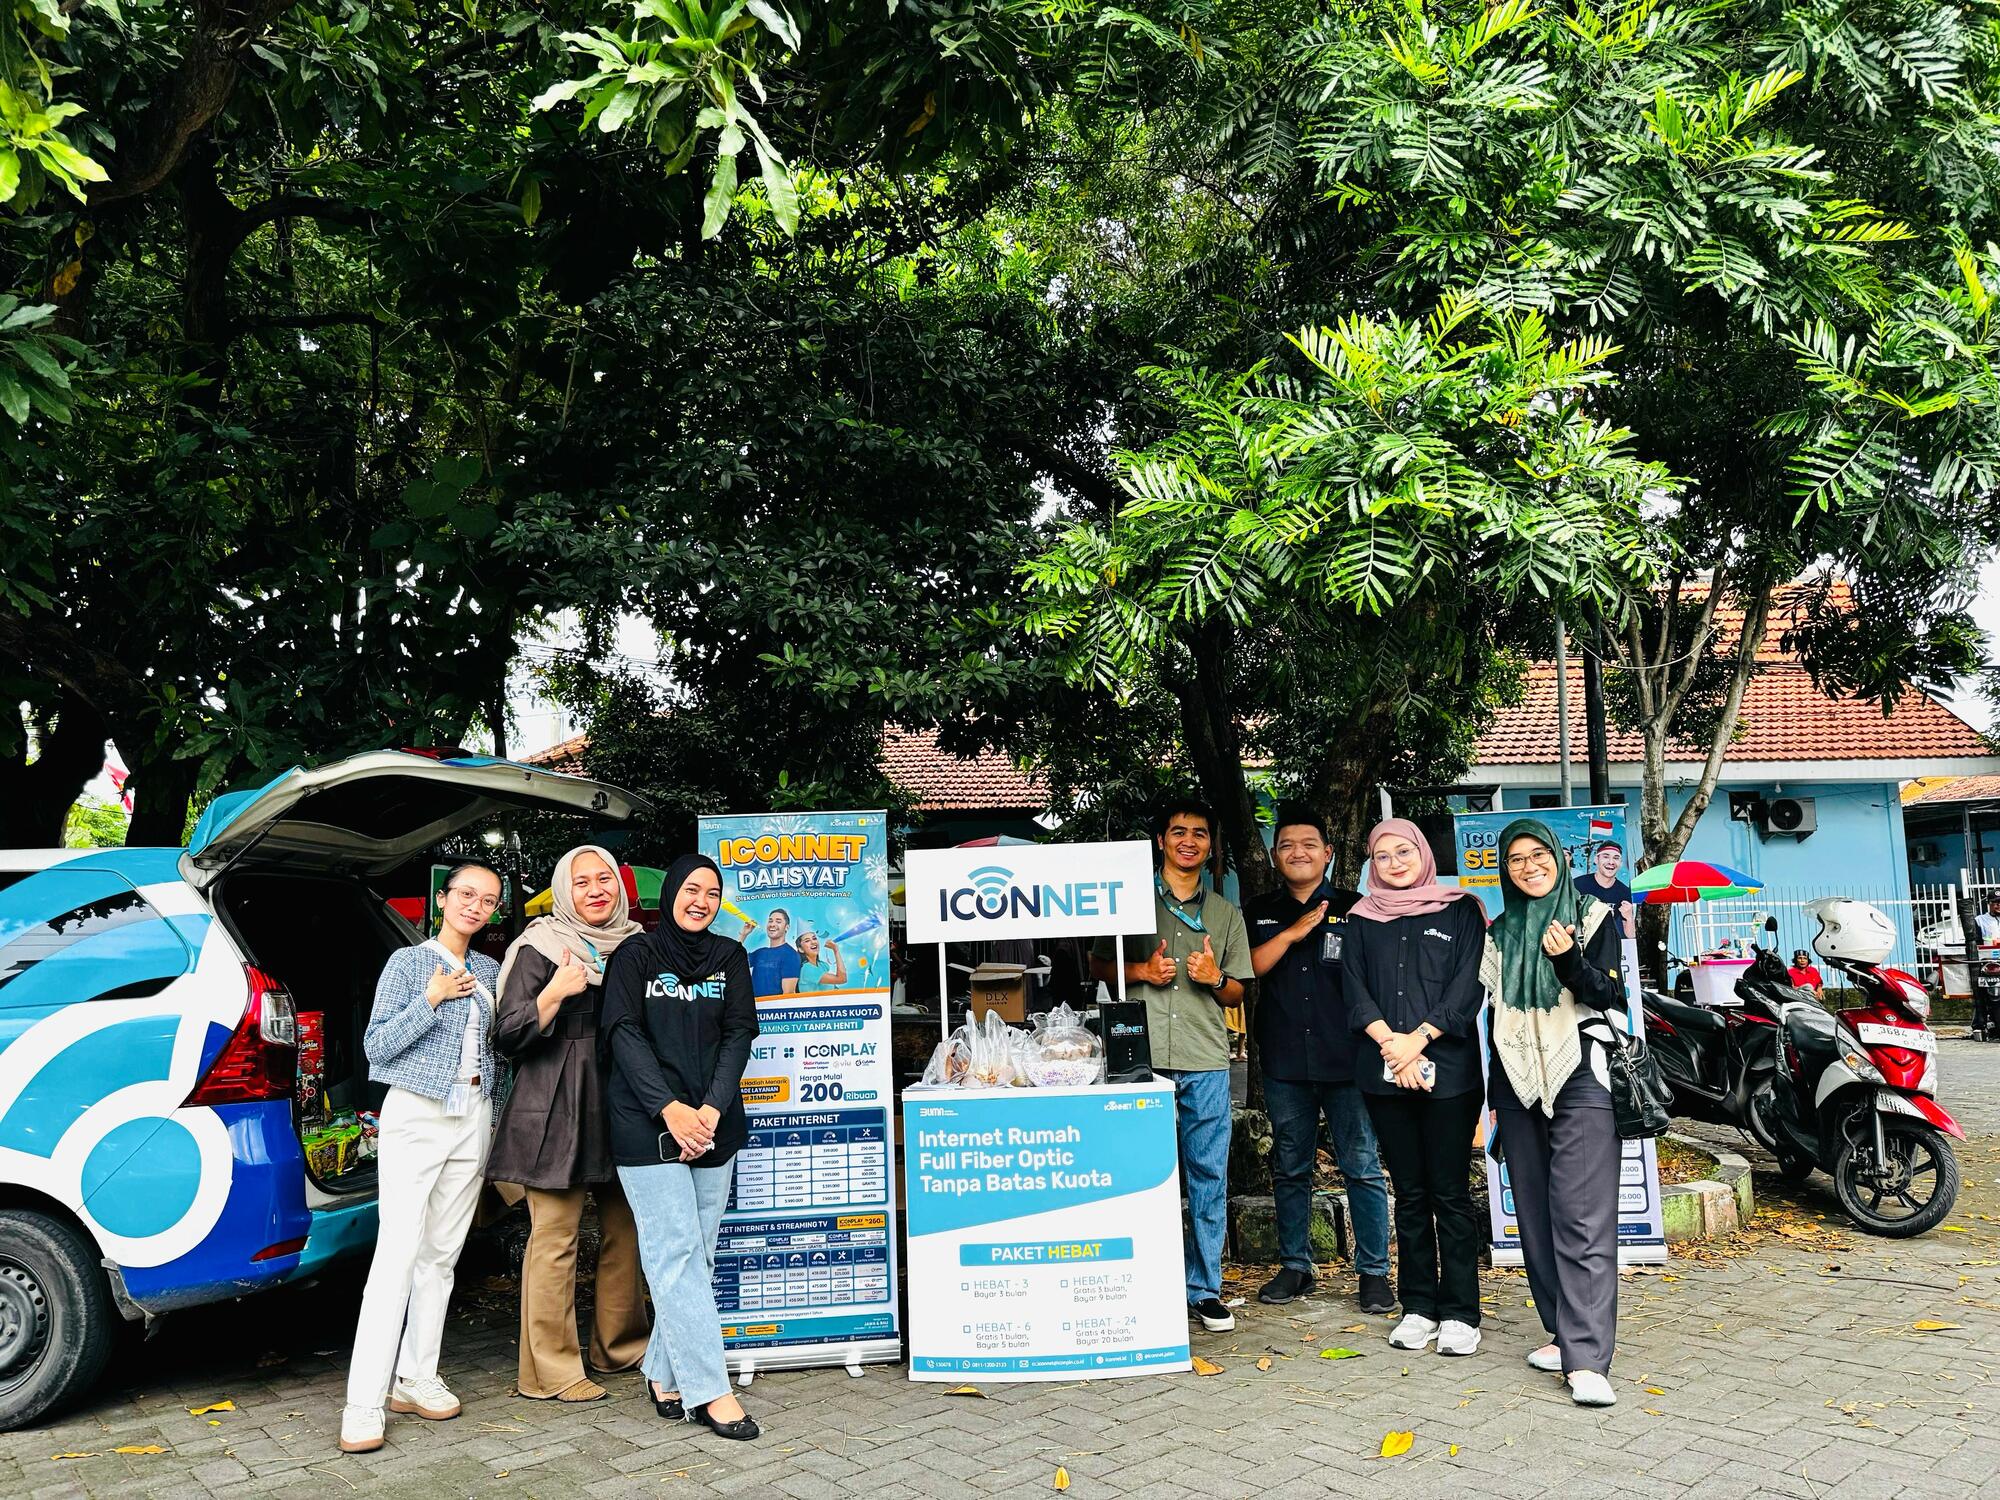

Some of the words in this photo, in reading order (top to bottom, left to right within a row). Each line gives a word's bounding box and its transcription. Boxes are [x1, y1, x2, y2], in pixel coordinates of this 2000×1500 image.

[1462, 831, 1501, 848] ICO
[720, 835, 867, 866] ICONNET
[1464, 849, 1499, 869] SE
[738, 866, 849, 889] DAHSYAT
[939, 875, 1124, 922] ICONNET
[645, 976, 726, 1001] ICONNET
[985, 992, 1008, 1001] DLX
[788, 1011, 818, 1019] TANPA
[819, 1010, 848, 1018] BATAS
[849, 1008, 879, 1017] KUOTA
[759, 1025, 790, 1033] EAMING
[803, 1023, 832, 1031] TANPA
[834, 1022, 858, 1030] HENTI
[1918, 1032, 1933, 1042] KG
[750, 1047, 776, 1060] NET
[804, 1042, 877, 1058] ICONPLAY
[800, 1074, 822, 1082] Harga
[800, 1082, 843, 1103] 200
[846, 1091, 876, 1100] Ribuan
[752, 1117, 786, 1128] PAKET
[789, 1114, 840, 1126] INTERNET
[919, 1129, 1003, 1148] Internet
[1008, 1125, 1081, 1145] Rumah
[920, 1152, 956, 1170] Full
[961, 1150, 1014, 1169] Fiber
[1018, 1149, 1075, 1171] Optic
[920, 1175, 981, 1197] Tanpa
[986, 1172, 1046, 1192] Batas
[1052, 1169, 1112, 1189] Kuota
[719, 1226, 733, 1234] KET
[734, 1224, 769, 1232] INTERNET
[777, 1221, 818, 1230] STREAMING
[818, 1220, 828, 1228] TV
[991, 1246, 1045, 1262] PAKET
[1048, 1243, 1102, 1259] HEBAT
[974, 1280, 1010, 1290] HEBAT
[1022, 1279, 1029, 1289] 3
[1073, 1275, 1110, 1286] HEBAT
[1122, 1274, 1133, 1284] 12
[974, 1290, 998, 1299] Bayar
[1005, 1289, 1027, 1297] bulan
[1073, 1286, 1096, 1294] Gratis
[1074, 1294, 1097, 1303] Bayar
[1105, 1292, 1127, 1300] bulan
[976, 1322, 1013, 1332] HEBAT
[1024, 1322, 1031, 1331] 6
[1075, 1318, 1112, 1329] HEBAT
[1124, 1316, 1137, 1326] 24
[975, 1333, 999, 1341] Gratis
[1075, 1328, 1099, 1337] Gratis
[1100, 1328, 1106, 1336] 4
[976, 1341, 1000, 1350] Bayar
[1001, 1340, 1007, 1348] 5
[1008, 1340, 1030, 1348] bulan
[1076, 1336, 1100, 1346] Bayar
[1112, 1335, 1134, 1343] bulan
